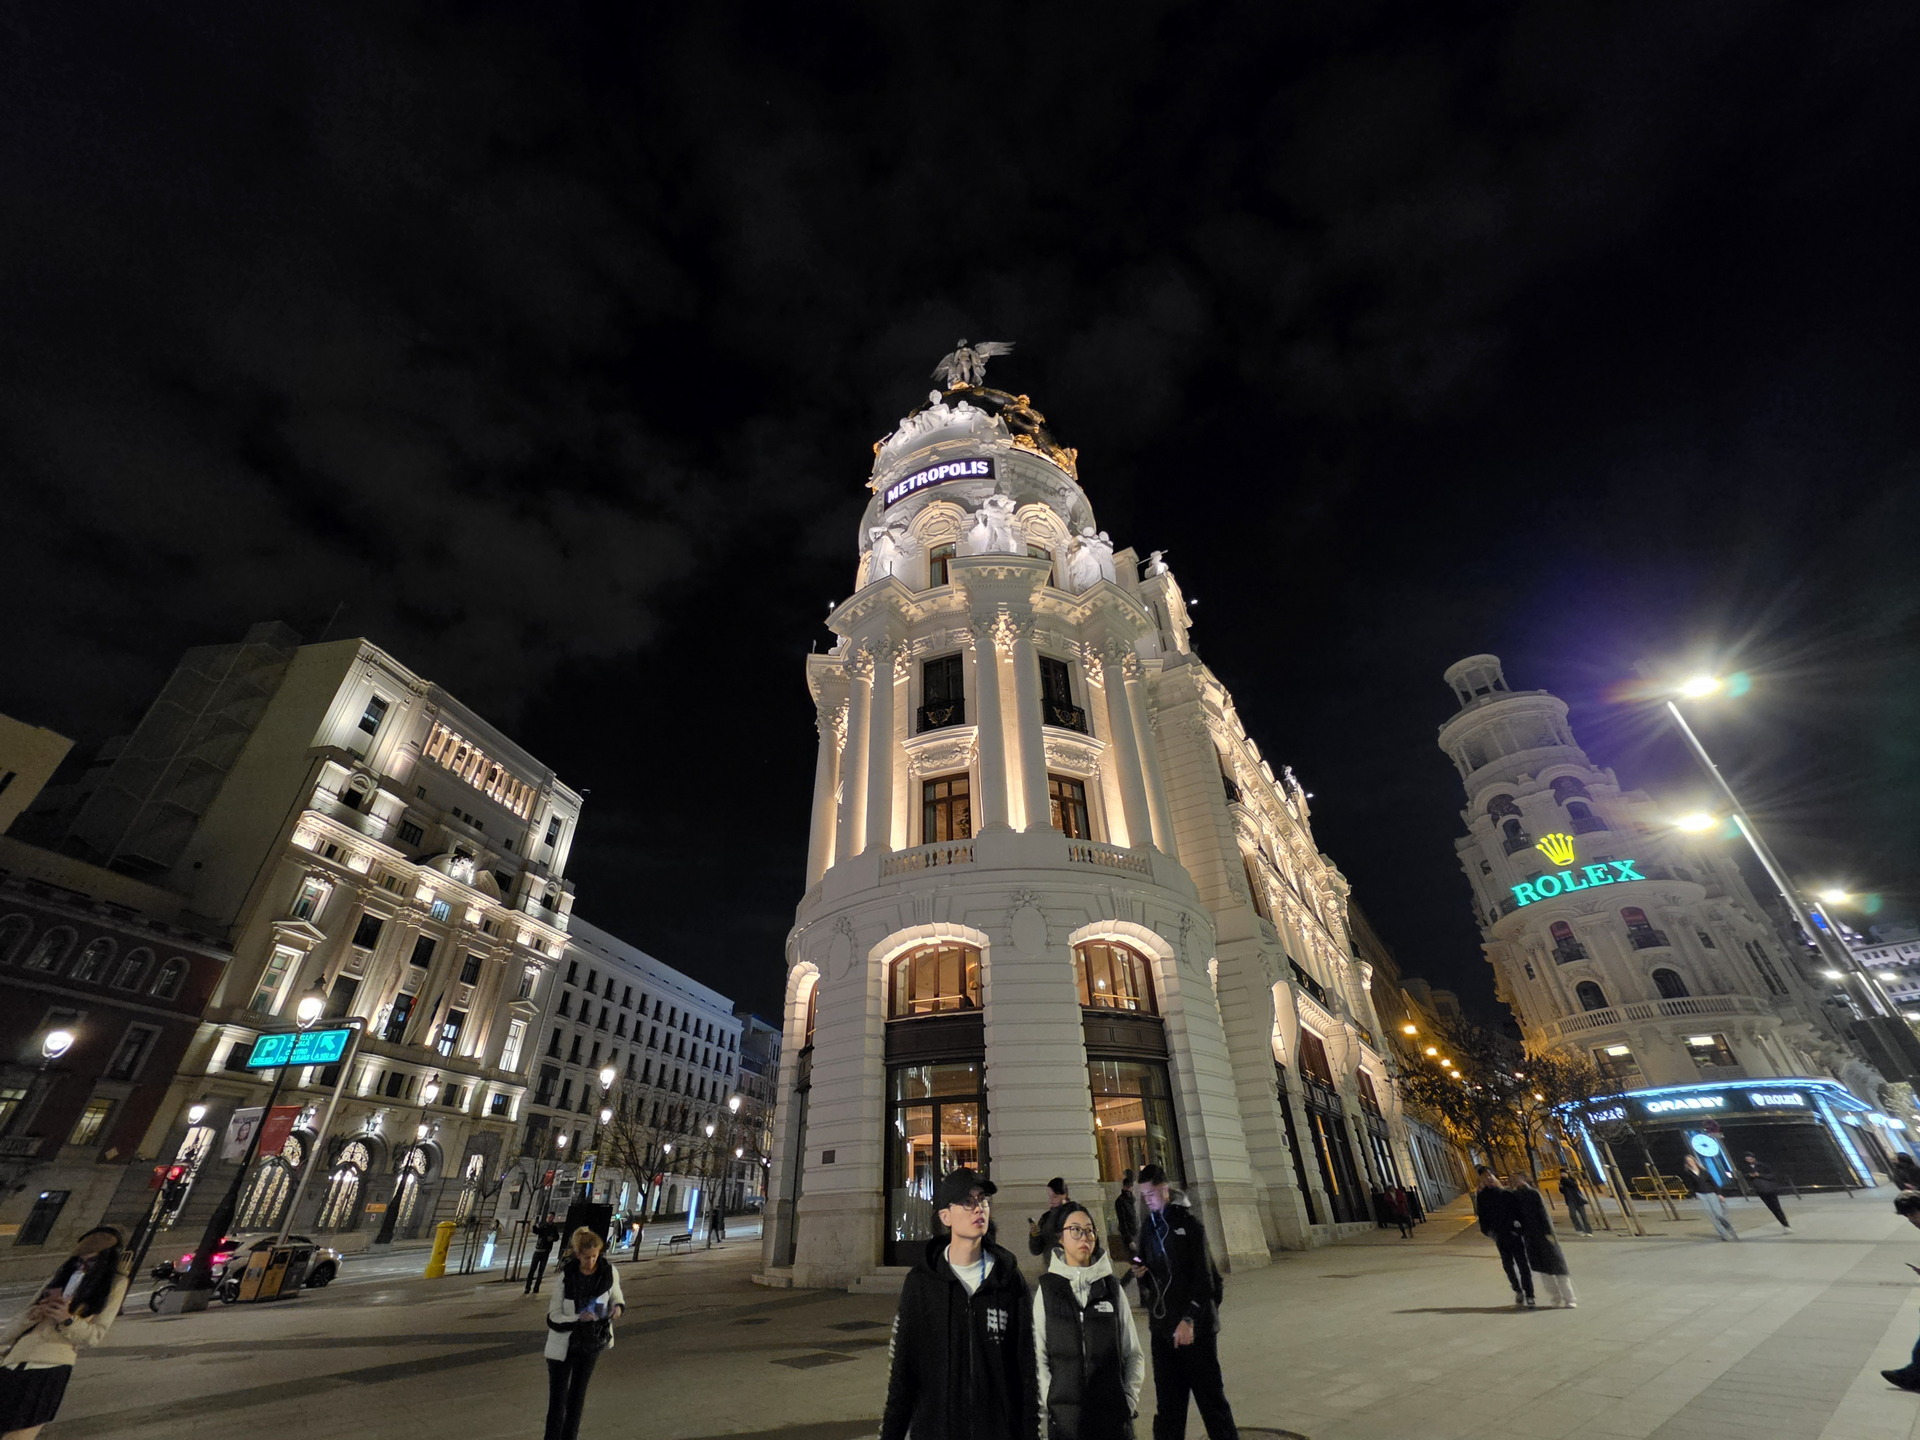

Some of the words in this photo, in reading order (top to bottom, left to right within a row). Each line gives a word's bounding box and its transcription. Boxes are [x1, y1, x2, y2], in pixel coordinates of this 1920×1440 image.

[887, 461, 989, 503] METROPOLIS
[1510, 859, 1646, 907] ROLEX
[261, 1039, 278, 1057] P
